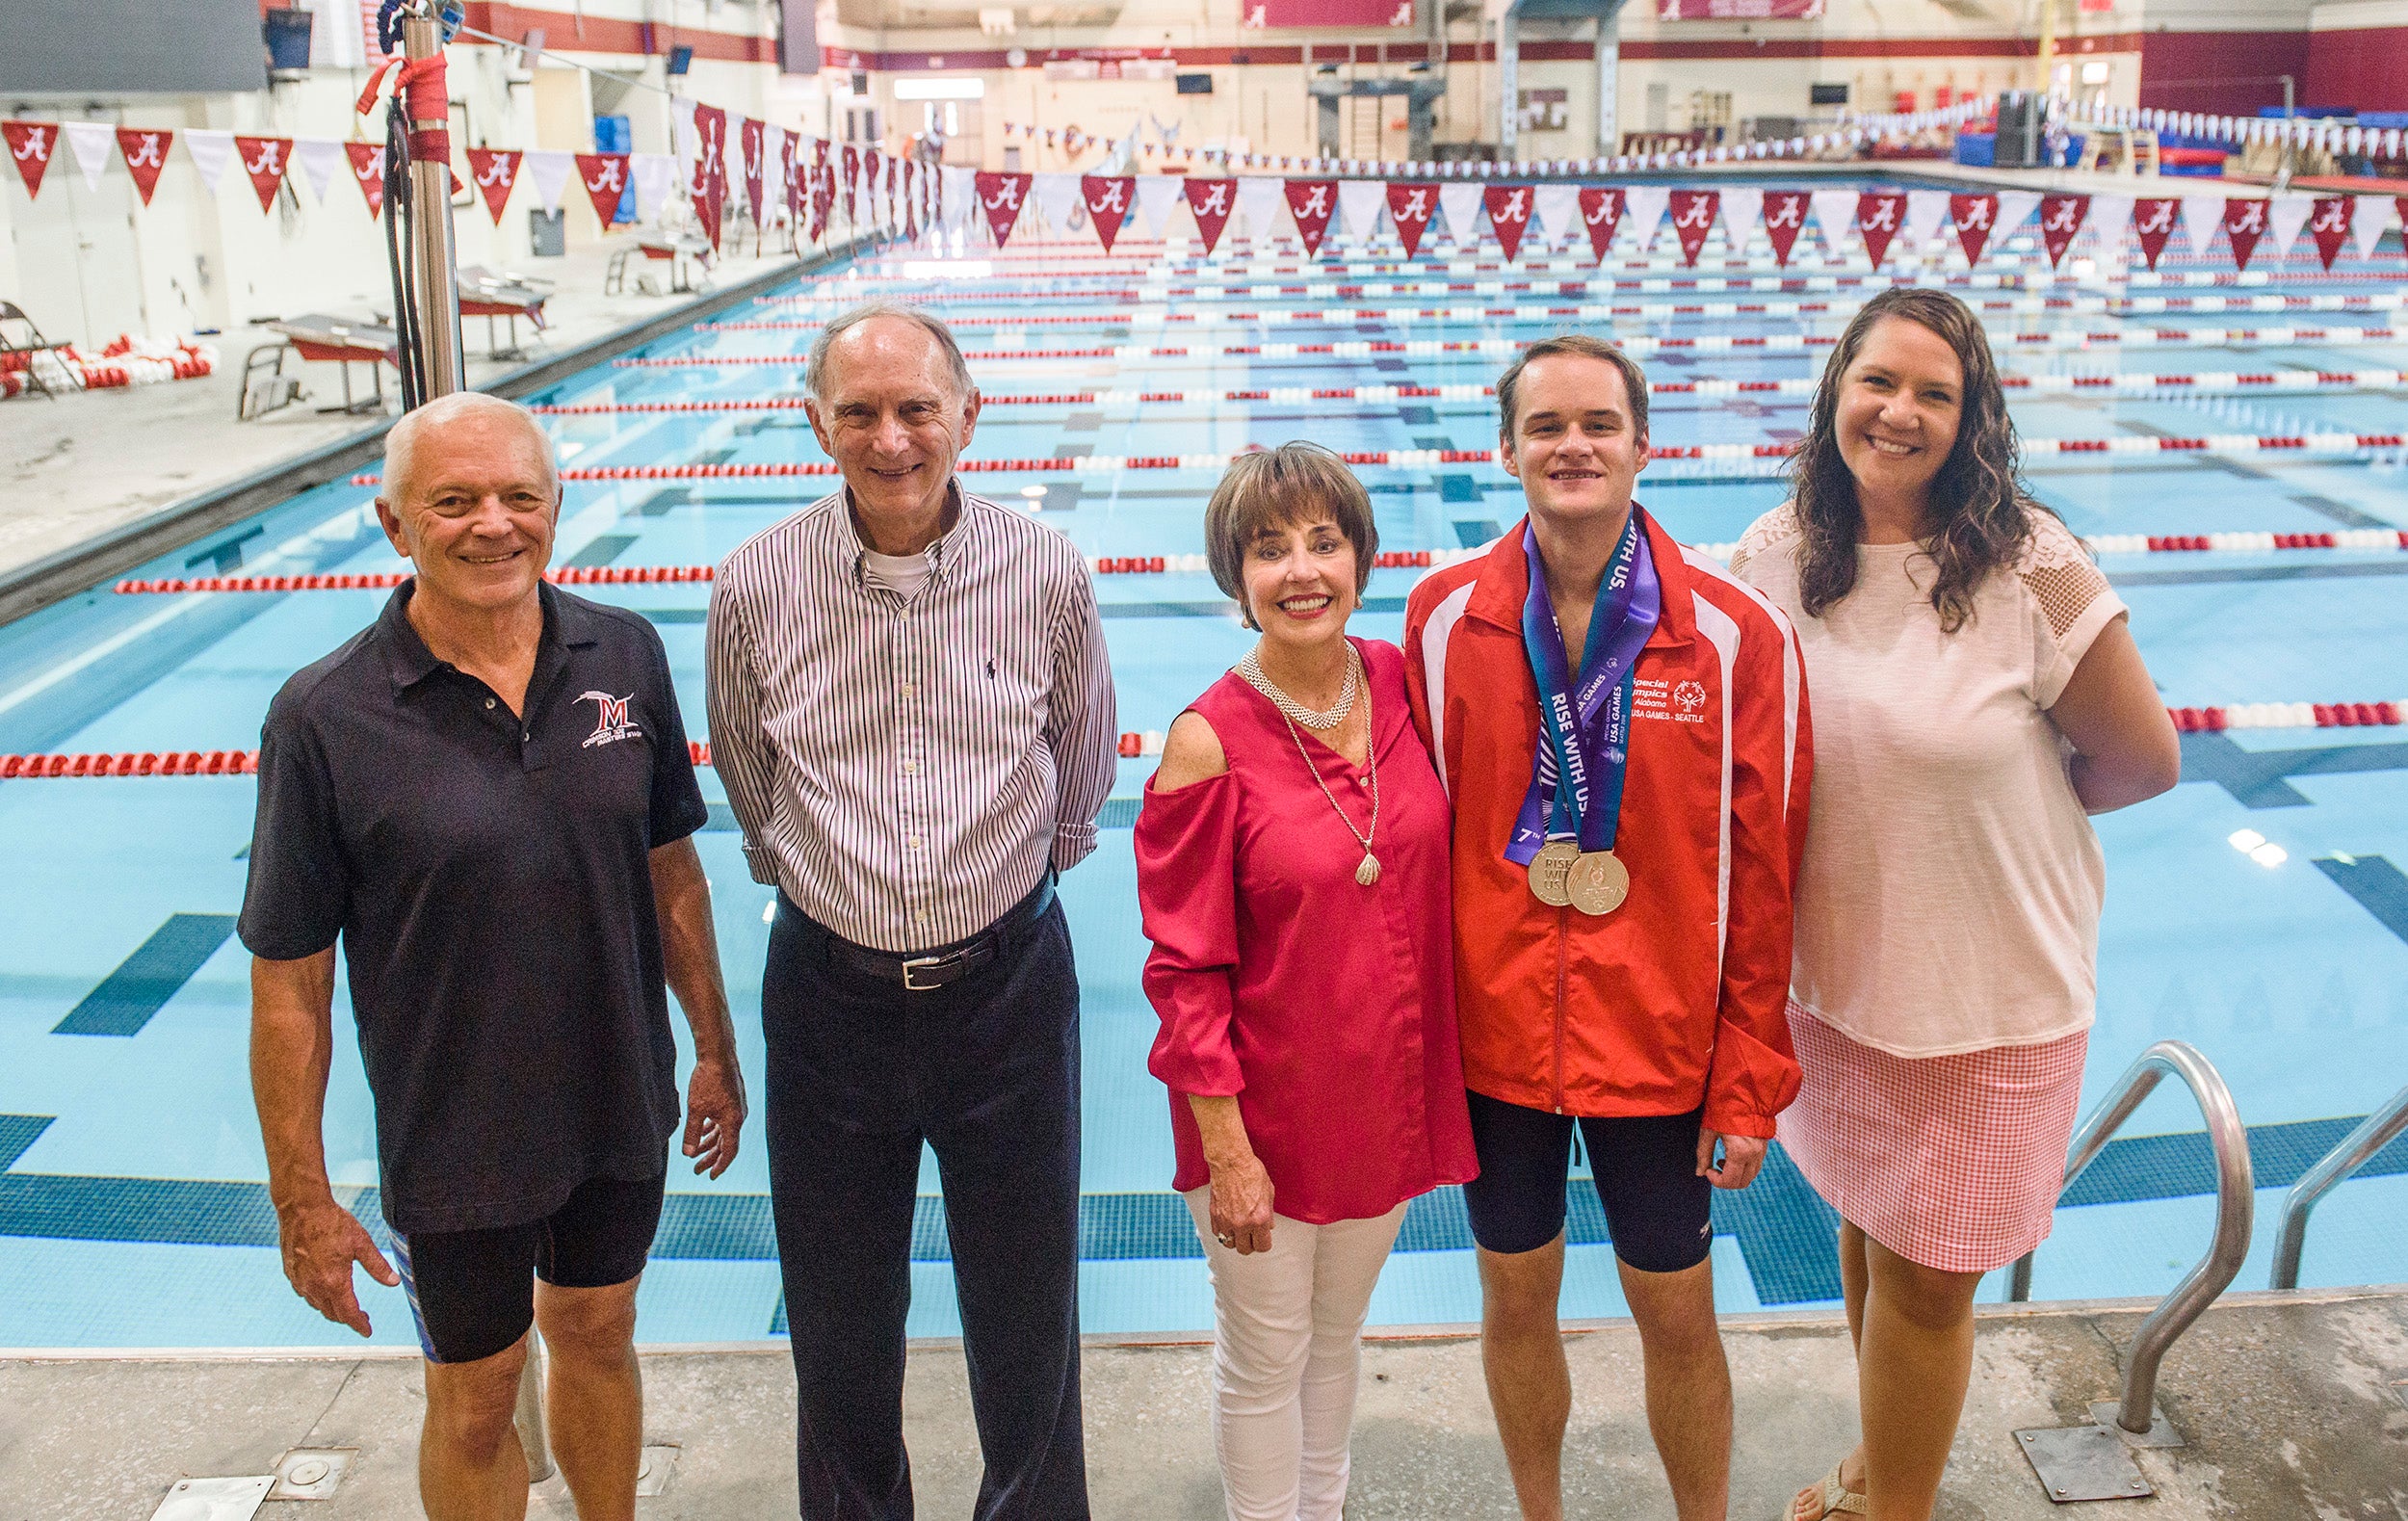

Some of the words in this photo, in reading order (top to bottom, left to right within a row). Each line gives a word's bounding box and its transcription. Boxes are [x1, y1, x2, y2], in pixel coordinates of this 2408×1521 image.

[14, 126, 47, 162] A
[128, 133, 162, 169] A
[247, 142, 283, 176] A
[477, 153, 513, 188] A
[588, 159, 622, 193] A
[985, 177, 1019, 210] A
[1091, 181, 1124, 213] A
[1193, 184, 1227, 217] A
[1295, 185, 1328, 219] A
[1394, 189, 1428, 222] A
[1494, 189, 1527, 223] A
[1586, 192, 1618, 225] A
[1678, 195, 1710, 227] A
[1769, 196, 1801, 228] A
[1861, 198, 1896, 232] A
[1957, 198, 1990, 232] A
[2043, 199, 2078, 232] A
[2140, 200, 2174, 234] A
[2230, 201, 2264, 235] A
[2312, 201, 2346, 233] A
[1608, 564, 1629, 590] US.
[1584, 673, 1606, 700] GAMES
[1635, 698, 1666, 708] Alabama
[589, 695, 638, 736] M
[1552, 693, 1573, 733] RISE
[1612, 686, 1622, 721] GAMES
[1631, 709, 1645, 718] USA
[1645, 710, 1670, 721] GAMES
[1675, 713, 1704, 723] SEATTLE
[1610, 723, 1619, 743] USA
[1562, 734, 1587, 785] WITH
[1544, 870, 1569, 879] WIT
[1546, 858, 1572, 870] RISE
